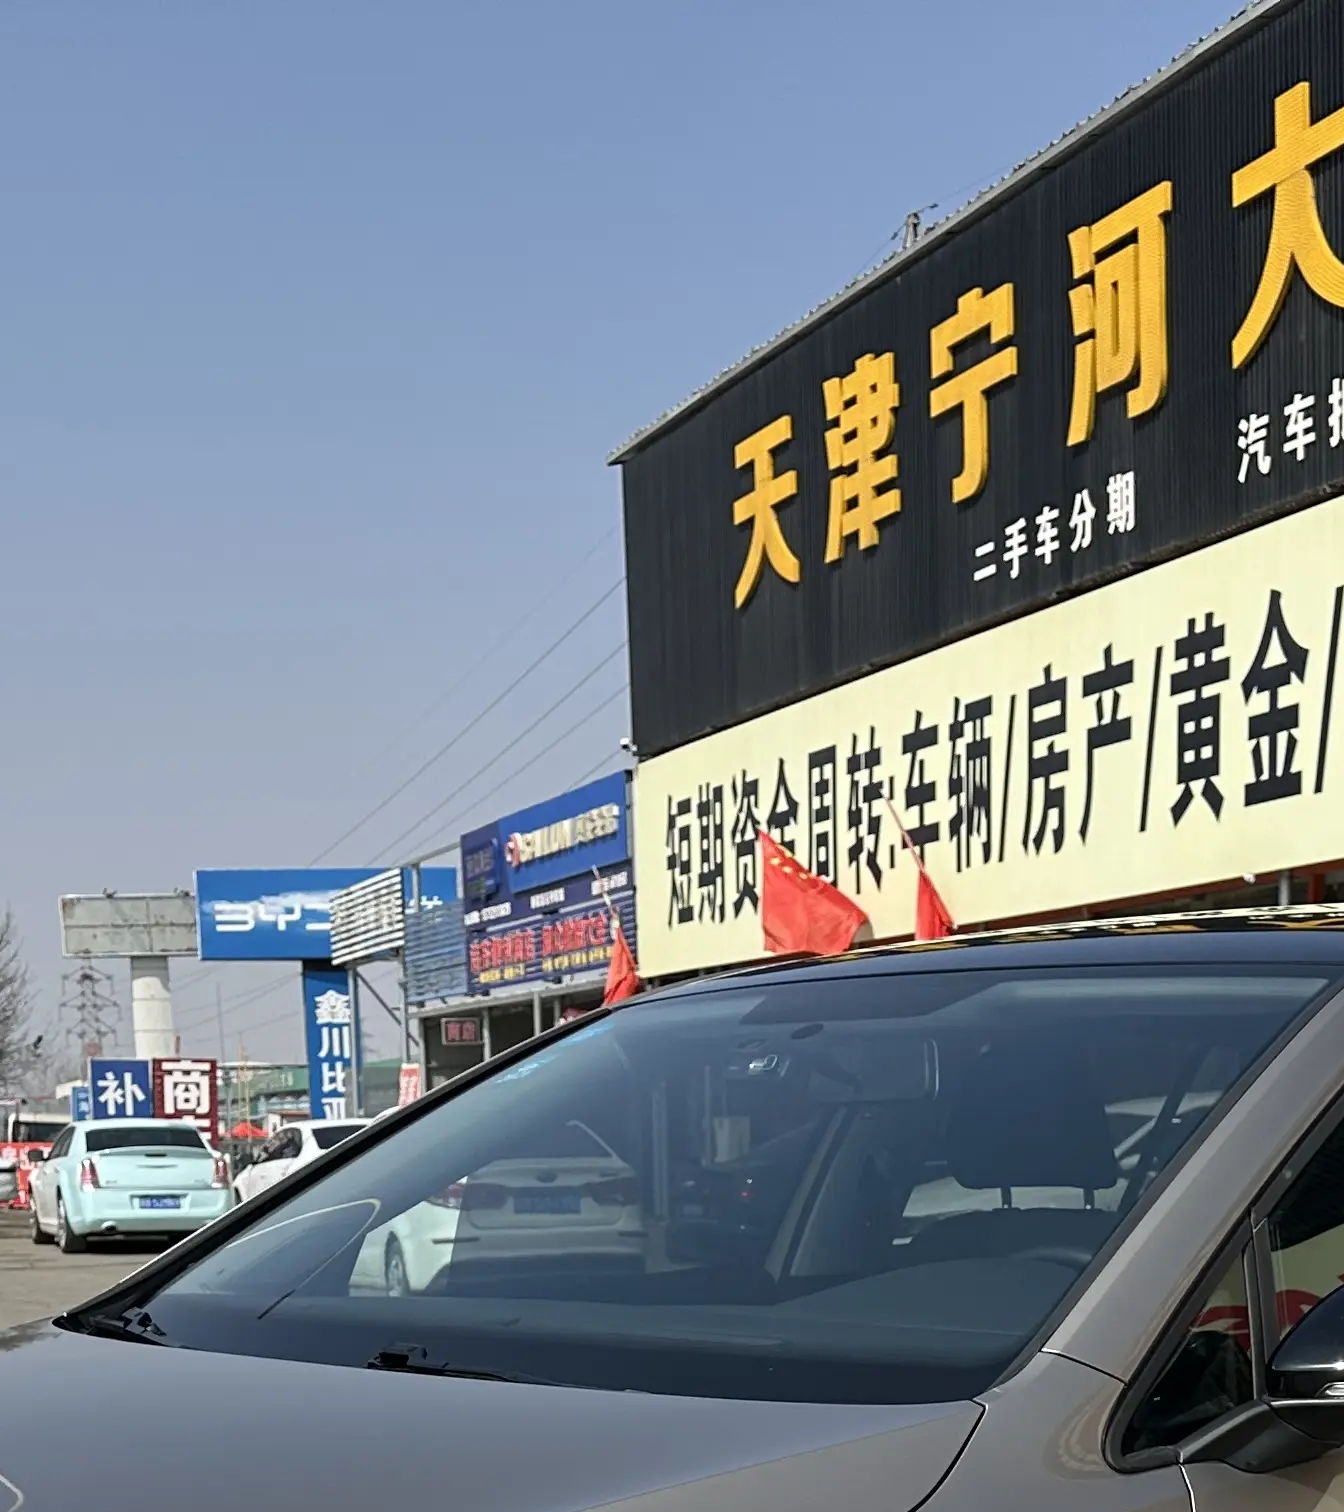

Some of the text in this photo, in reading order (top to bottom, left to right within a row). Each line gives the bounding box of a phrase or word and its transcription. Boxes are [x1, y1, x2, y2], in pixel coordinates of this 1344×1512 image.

[972, 470, 1138, 583] 二手车分期
[97, 1071, 146, 1116] 补
